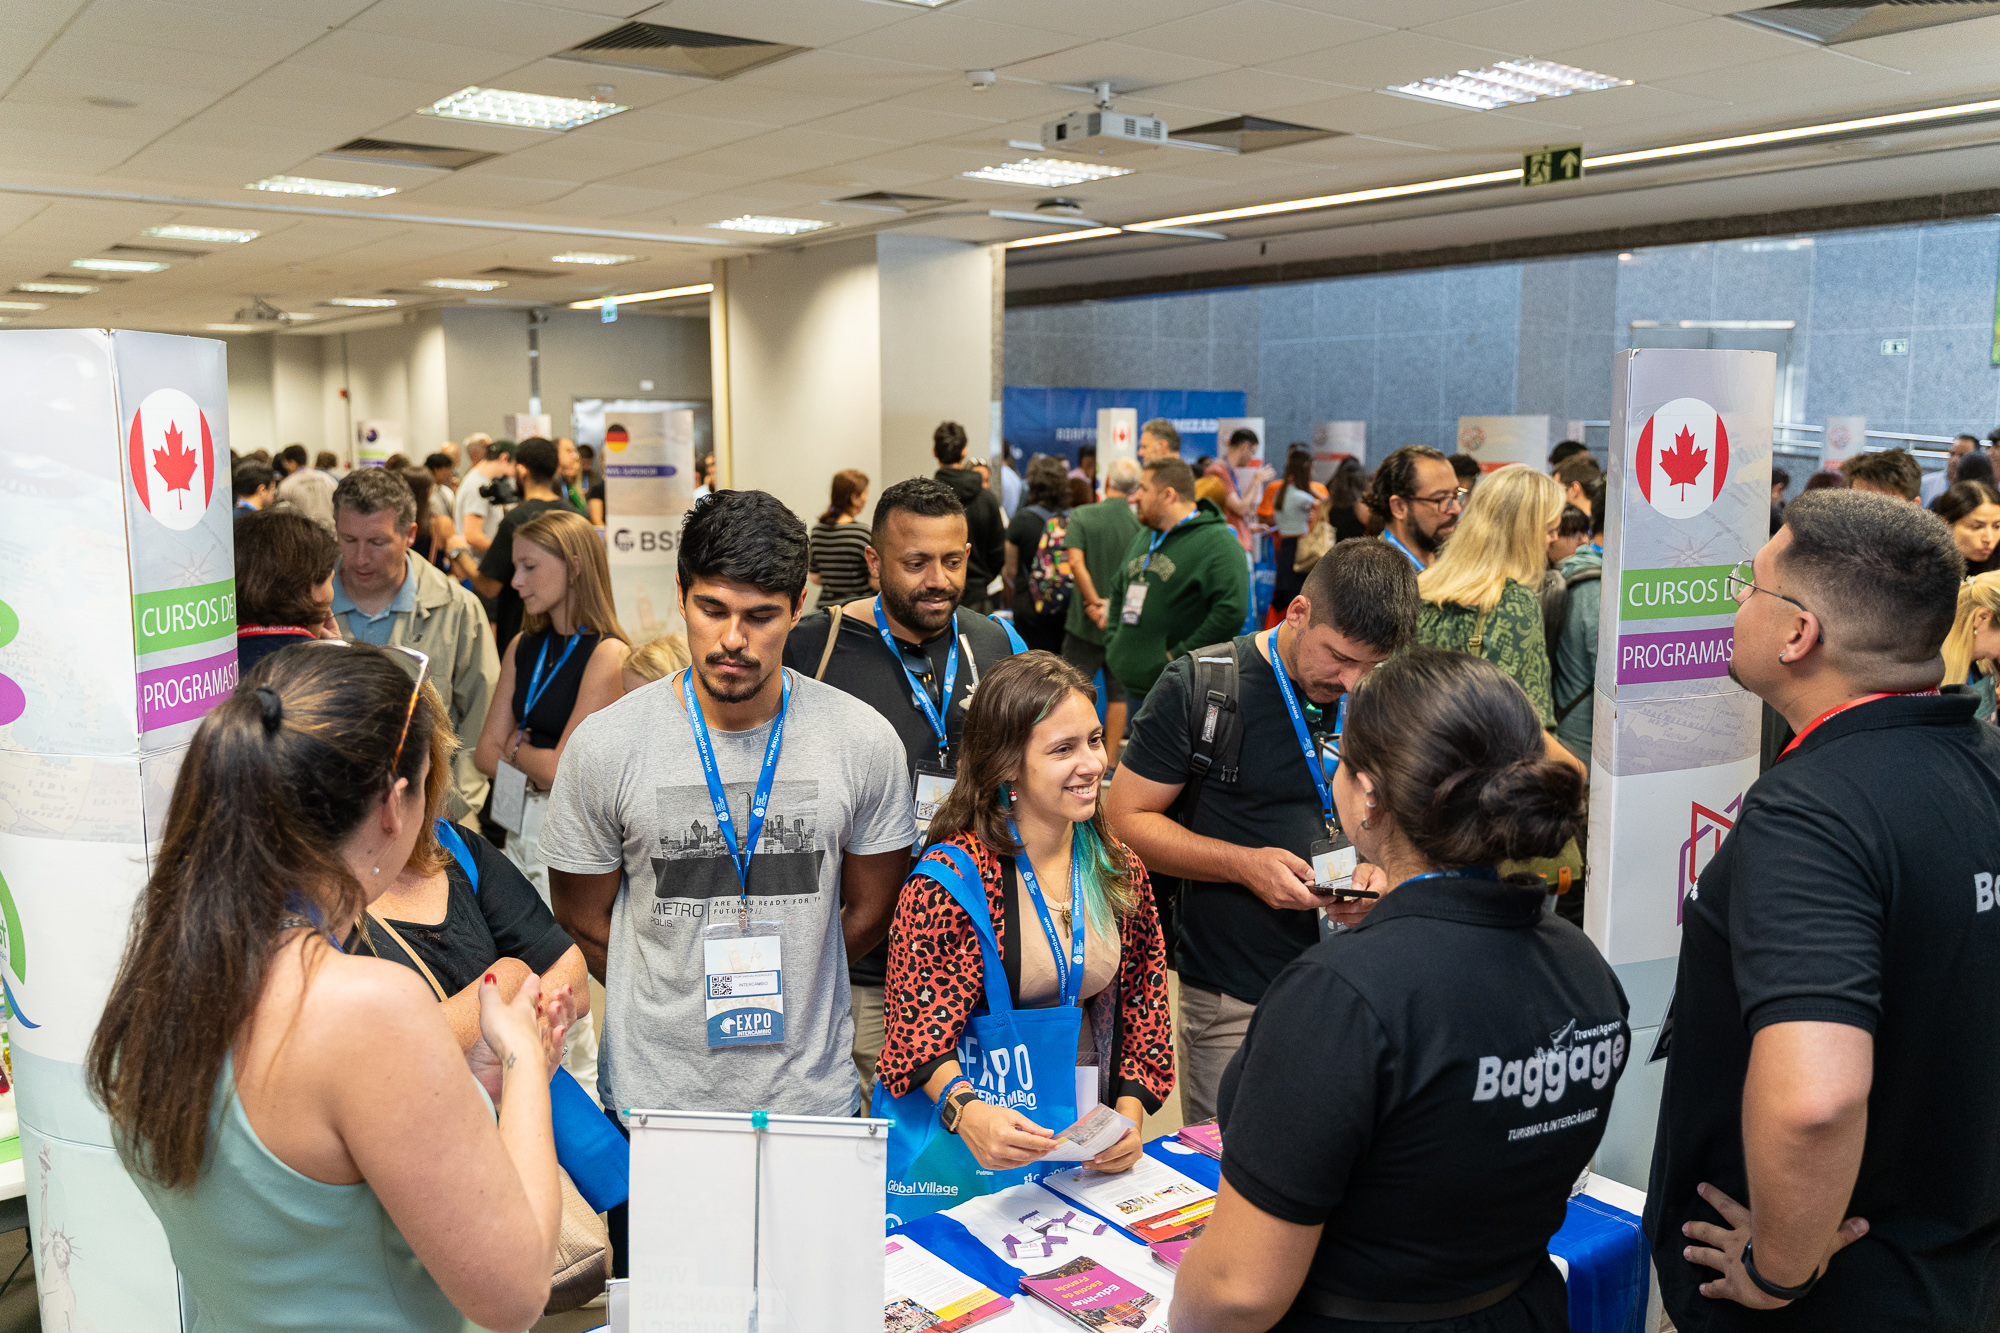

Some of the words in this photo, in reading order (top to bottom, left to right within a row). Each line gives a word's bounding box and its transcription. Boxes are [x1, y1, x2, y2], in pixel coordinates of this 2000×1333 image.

[1628, 578, 1718, 607] CURSOS
[141, 597, 219, 637] CURSOS
[220, 595, 235, 622] DE
[1622, 637, 1735, 670] PROGRAMAS
[143, 669, 234, 714] PROGRAMAS
[650, 901, 704, 918] METRO
[758, 898, 788, 907] READY
[792, 897, 809, 906] FOR
[736, 1012, 772, 1031] EXPO
[1471, 1034, 1627, 1109] Baggage
[1507, 1122, 1542, 1142] TURISMO
[1542, 1121, 1549, 1134] &
[1548, 1107, 1599, 1132] INTERCÂMBIO
[887, 1179, 917, 1194] Global
[917, 1180, 959, 1196] Village
[1061, 1291, 1075, 1300] de
[1069, 1283, 1121, 1309] Edu-Inter
[1074, 1279, 1104, 1296] Escola
